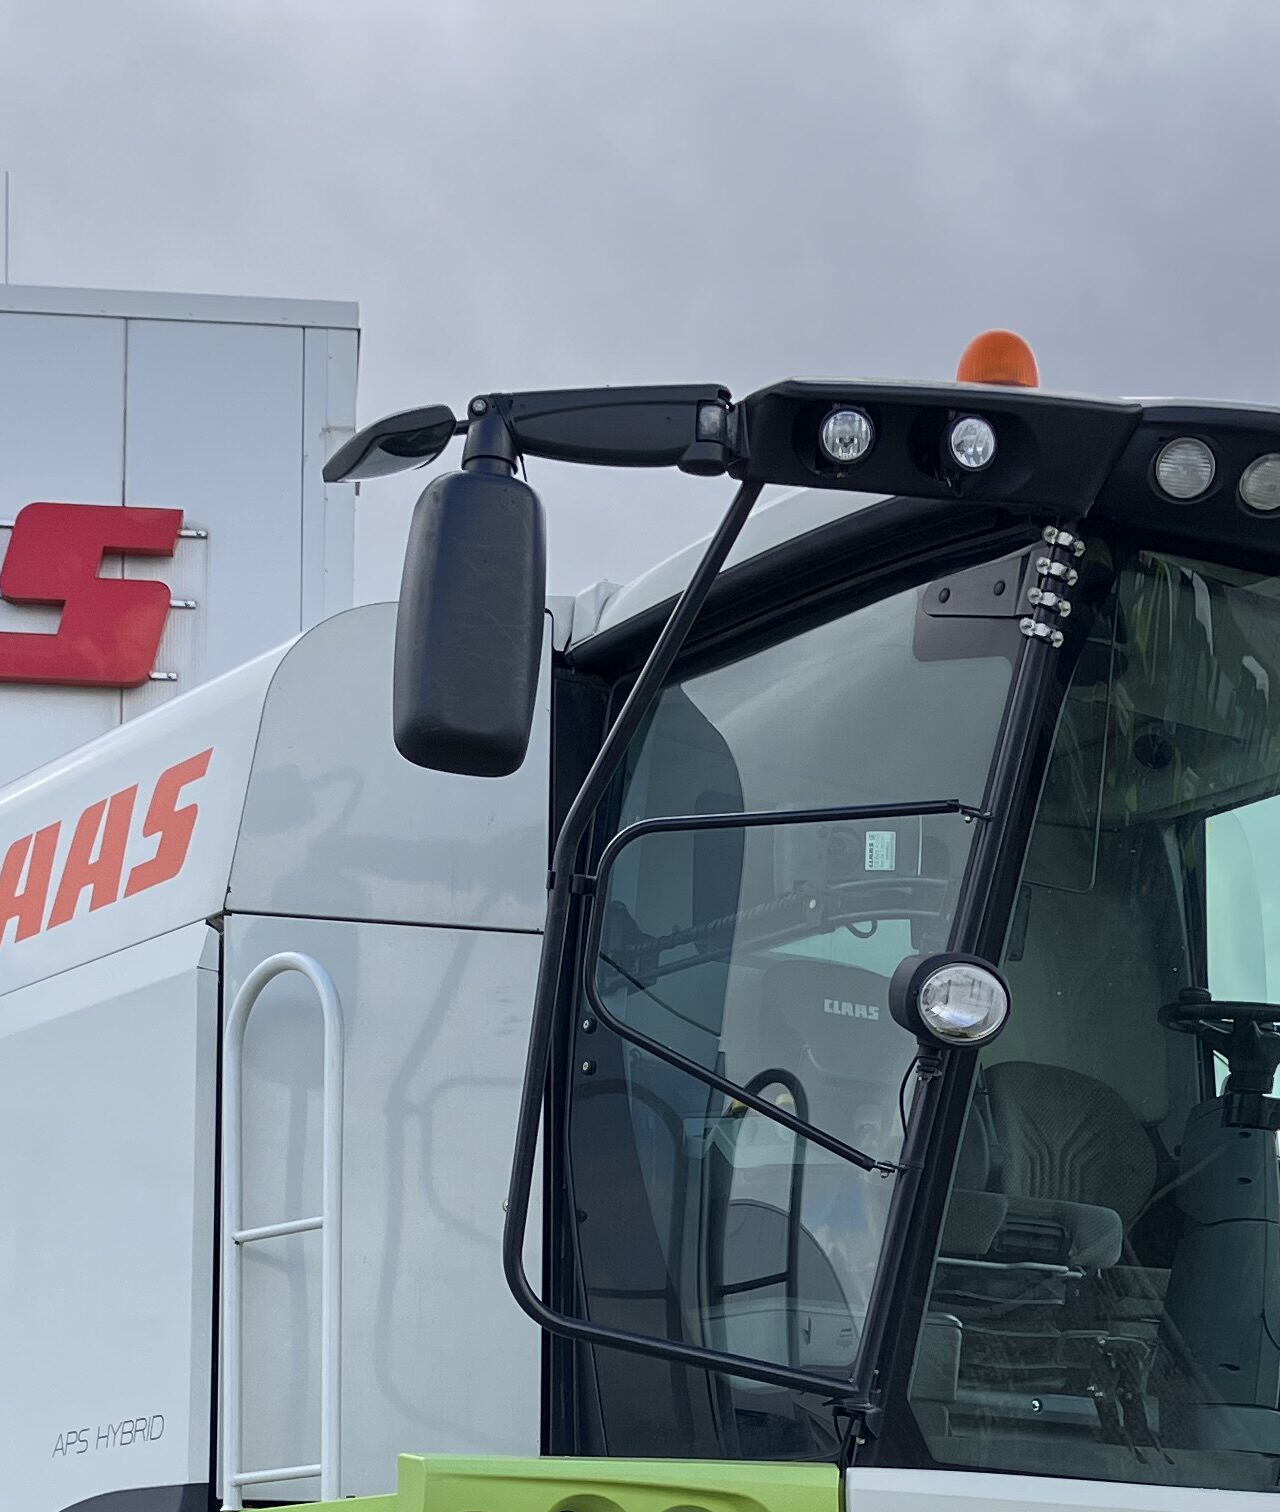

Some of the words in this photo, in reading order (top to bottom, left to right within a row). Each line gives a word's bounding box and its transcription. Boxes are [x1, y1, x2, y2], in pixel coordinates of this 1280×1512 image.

[823, 998, 880, 1021] CLAAS
[51, 1428, 91, 1458] APS
[95, 1414, 165, 1450] HYBRID
